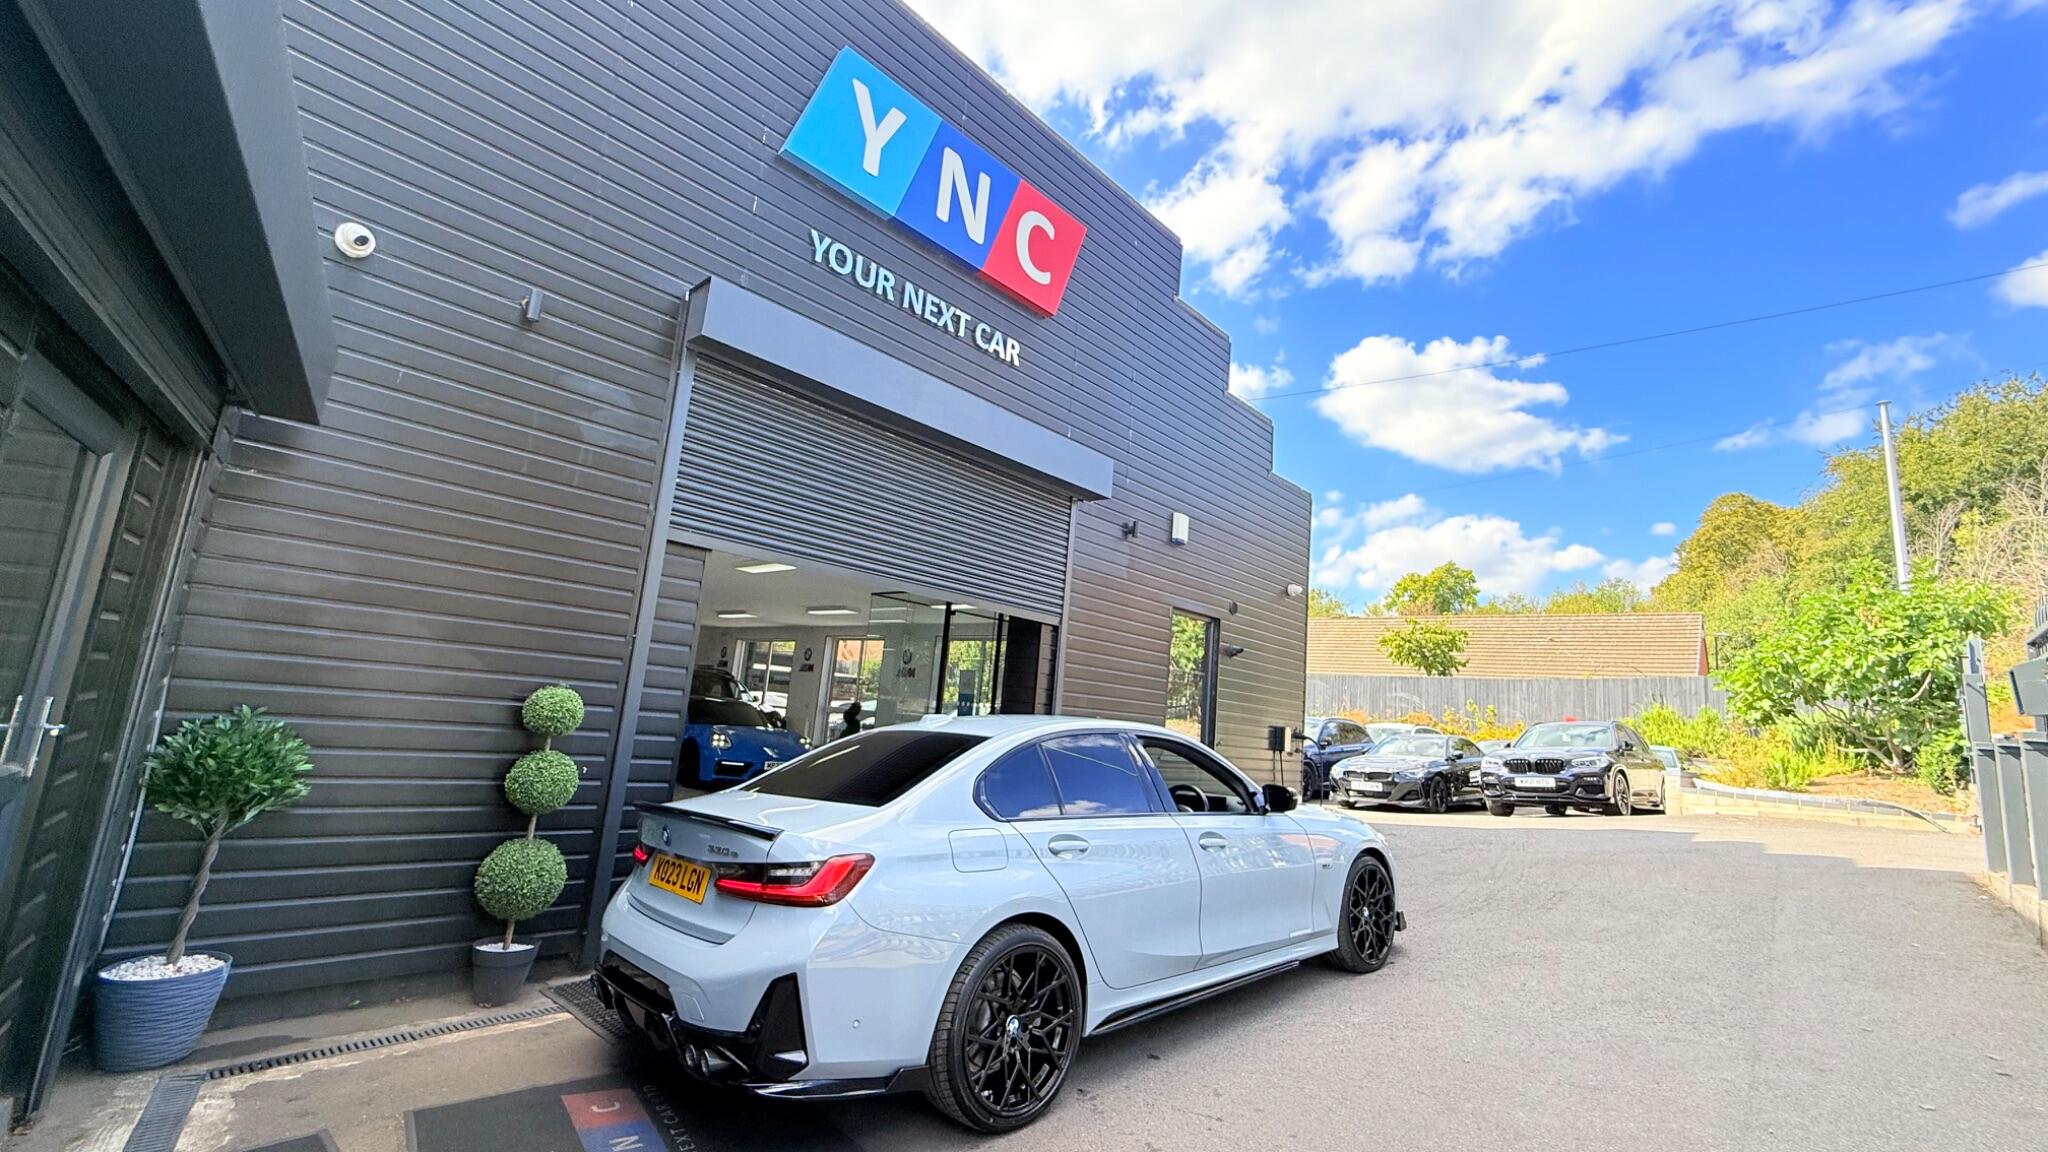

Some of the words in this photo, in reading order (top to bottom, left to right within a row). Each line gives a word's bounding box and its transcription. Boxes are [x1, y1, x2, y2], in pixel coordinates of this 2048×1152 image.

[852, 78, 1055, 285] YNC
[809, 228, 896, 301] YOUR
[901, 282, 971, 338] NEXT
[975, 322, 1022, 367] CAR
[679, 866, 706, 895] LGN
[655, 1103, 680, 1125] CAR
